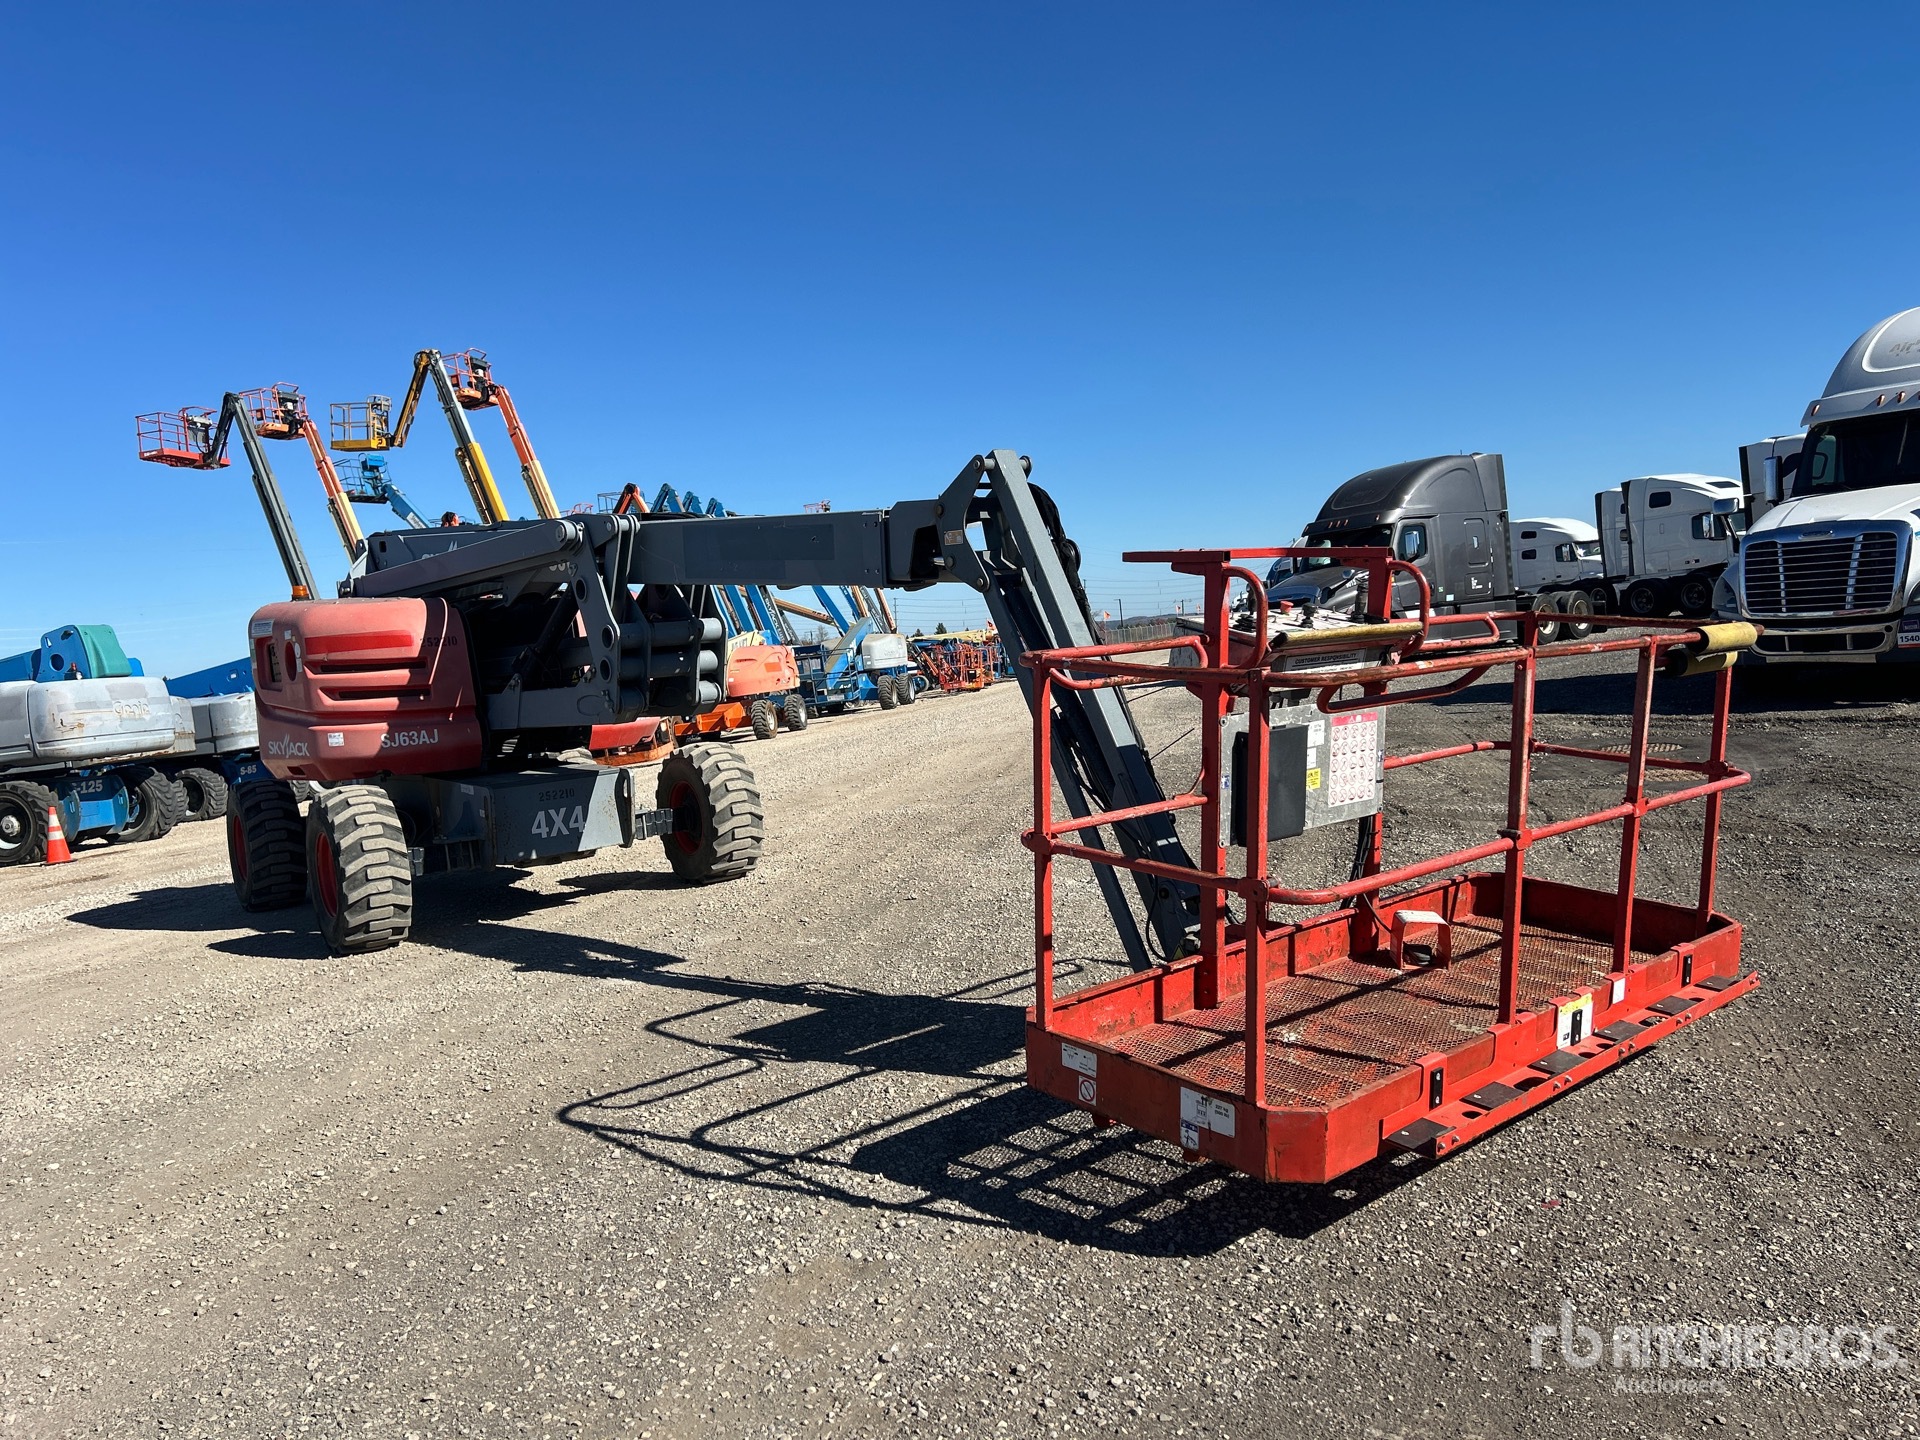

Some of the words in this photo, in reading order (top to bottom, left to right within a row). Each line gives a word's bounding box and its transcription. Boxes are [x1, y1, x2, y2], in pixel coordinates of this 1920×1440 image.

[1900, 635, 1920, 643] 1540
[1295, 656, 1320, 665] CUSTOMER
[1321, 653, 1357, 662] RESPONSIBILITY
[113, 700, 150, 718] Genie
[268, 733, 310, 759] SKYJACK
[381, 729, 439, 748] SJ63AJ
[240, 764, 257, 776] S-85
[538, 788, 575, 802] 252210
[532, 805, 586, 839] 4X4
